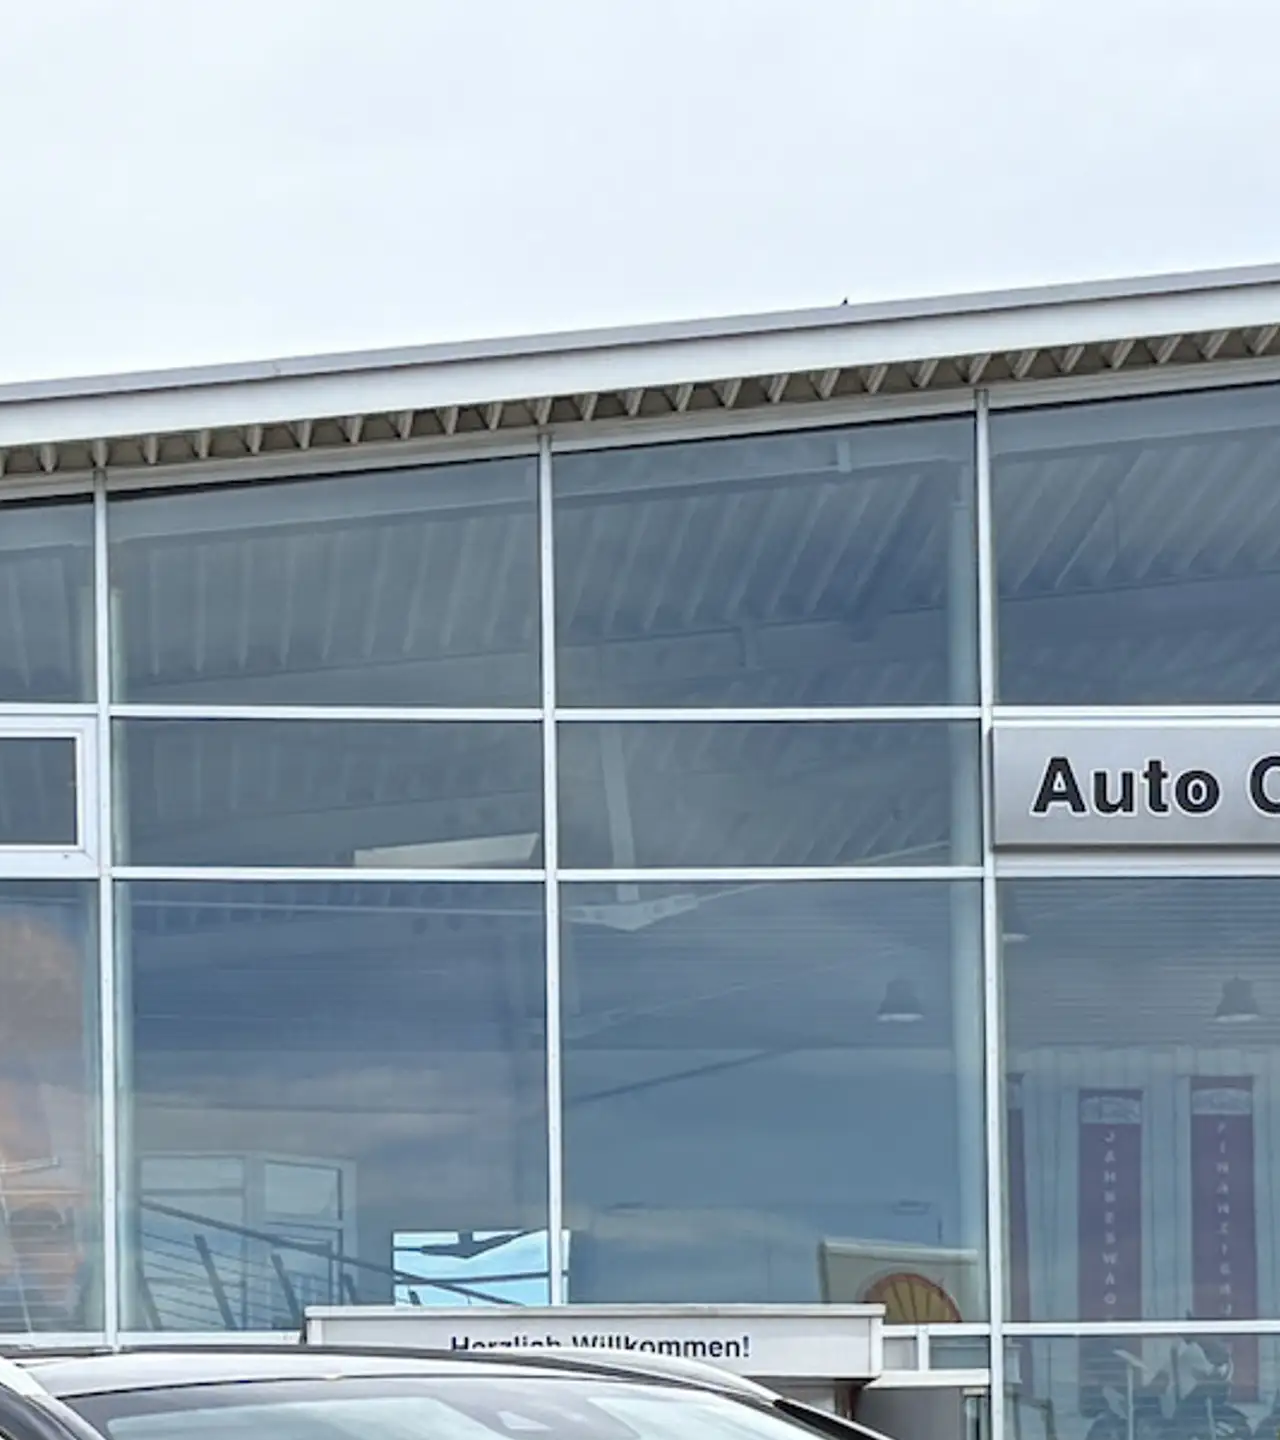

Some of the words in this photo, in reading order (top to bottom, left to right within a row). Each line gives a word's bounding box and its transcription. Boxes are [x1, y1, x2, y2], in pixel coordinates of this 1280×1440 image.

[1032, 756, 1221, 814] Auto
[1102, 1130, 1118, 1312] JAHRESWAG
[450, 1335, 560, 1350] Herlih
[572, 1334, 750, 1358] Willkommen!
